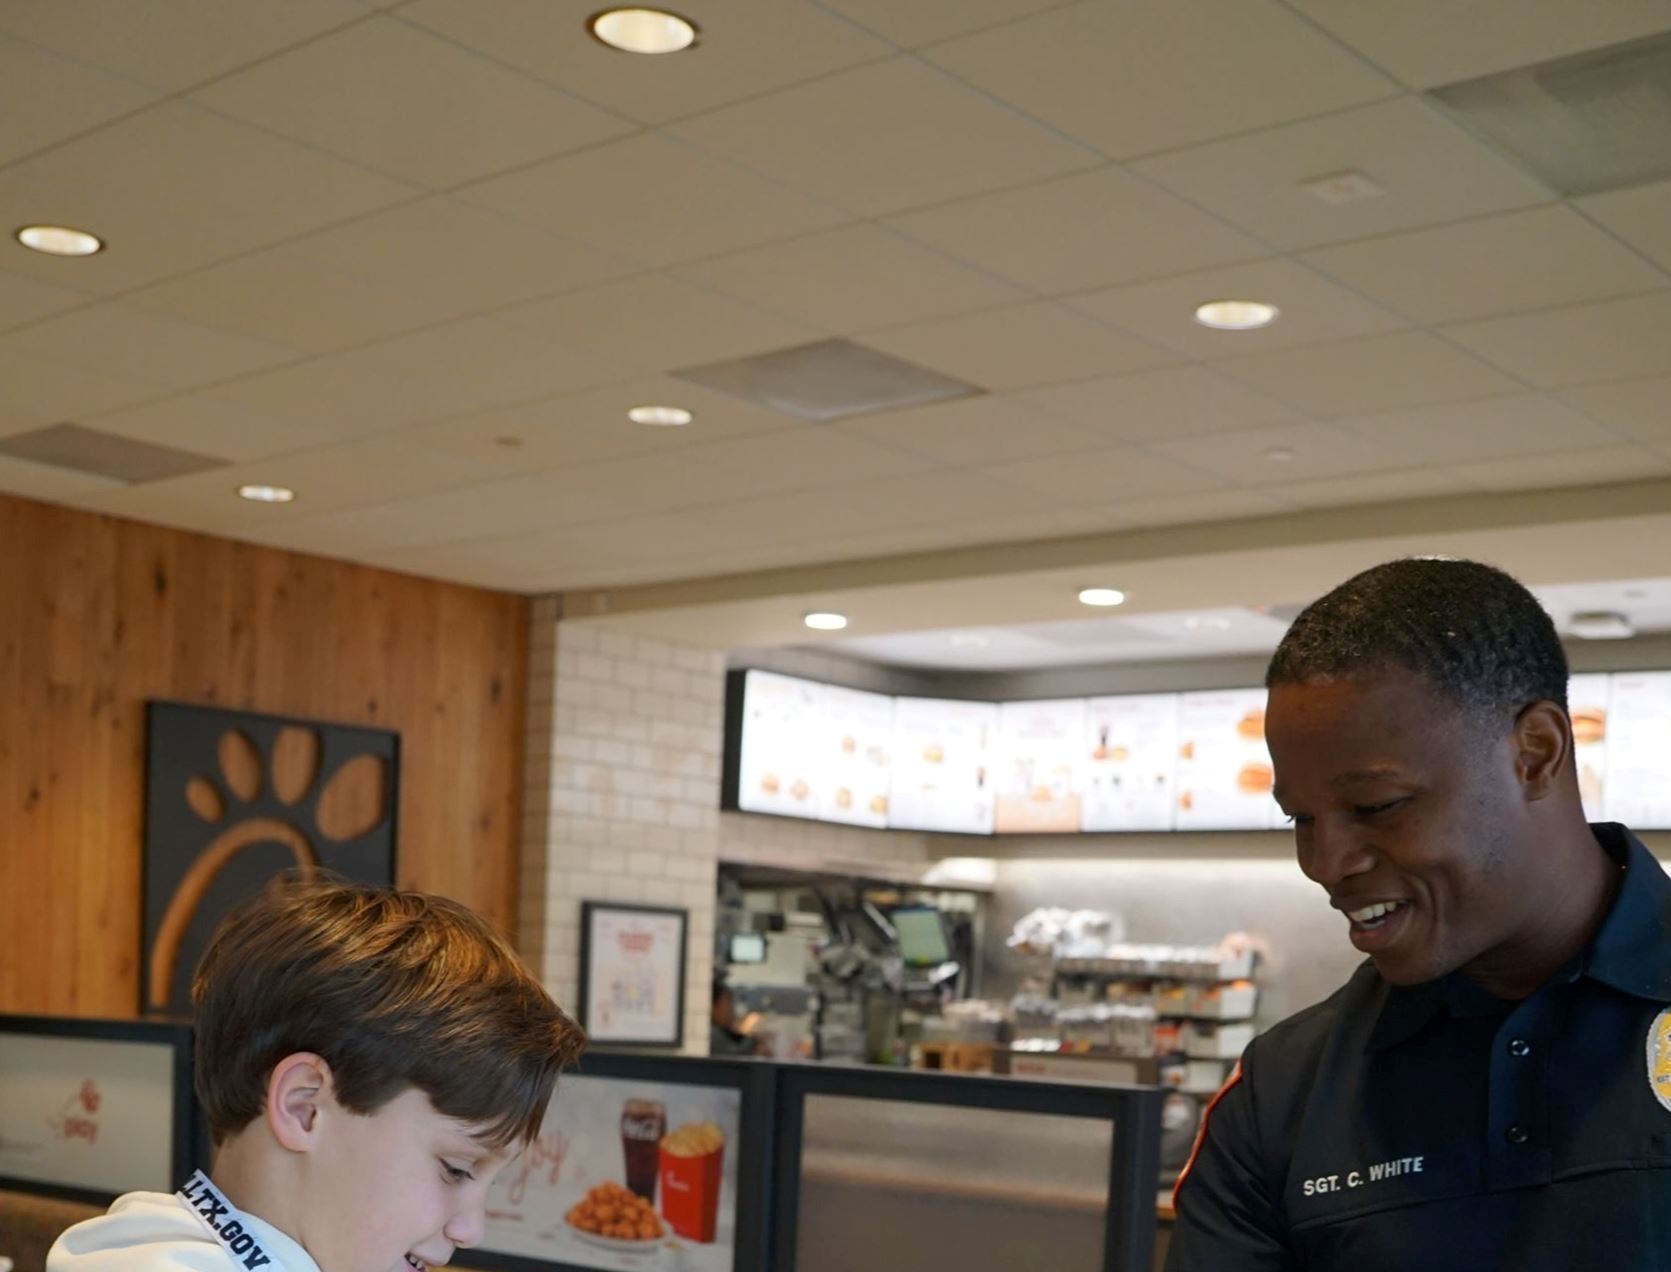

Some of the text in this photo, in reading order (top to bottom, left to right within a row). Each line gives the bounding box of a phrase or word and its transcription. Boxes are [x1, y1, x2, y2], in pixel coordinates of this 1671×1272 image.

[1303, 1156, 1424, 1196] SGT. C. WHITE
